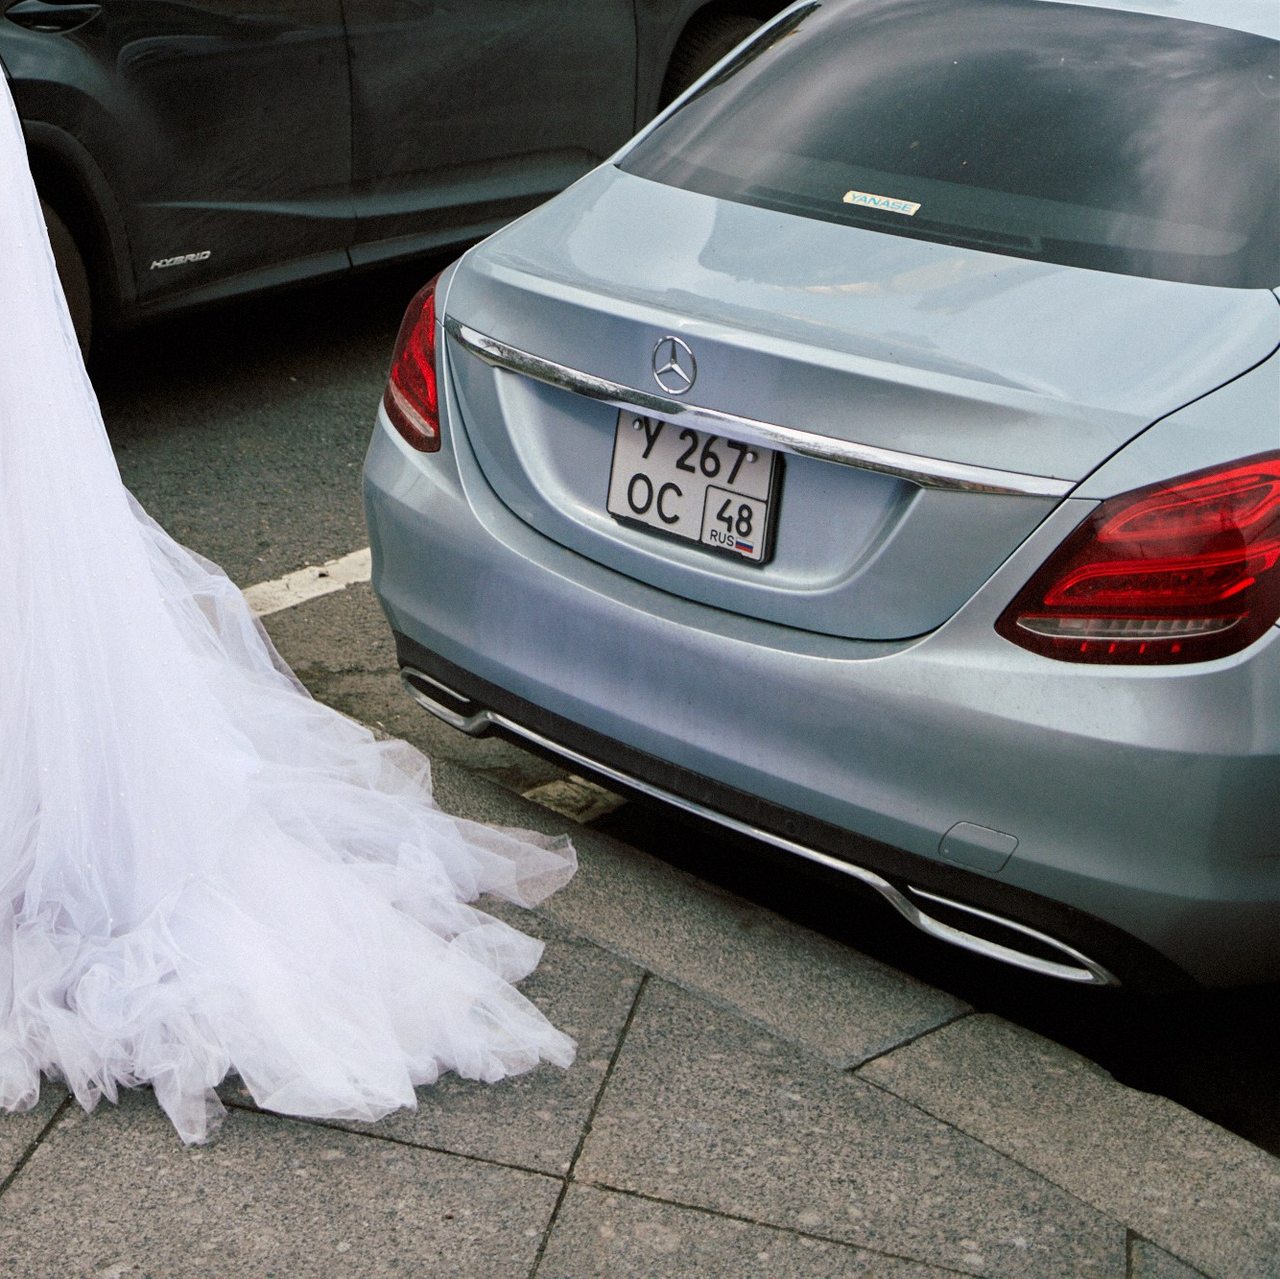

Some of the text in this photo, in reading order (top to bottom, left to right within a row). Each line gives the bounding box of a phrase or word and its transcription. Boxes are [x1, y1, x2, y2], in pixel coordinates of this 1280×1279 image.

[850, 192, 915, 213] YANASE
[150, 250, 211, 270] HYBRID
[675, 428, 749, 485] 267
[716, 498, 753, 538] 48
[709, 528, 734, 547] RUS
